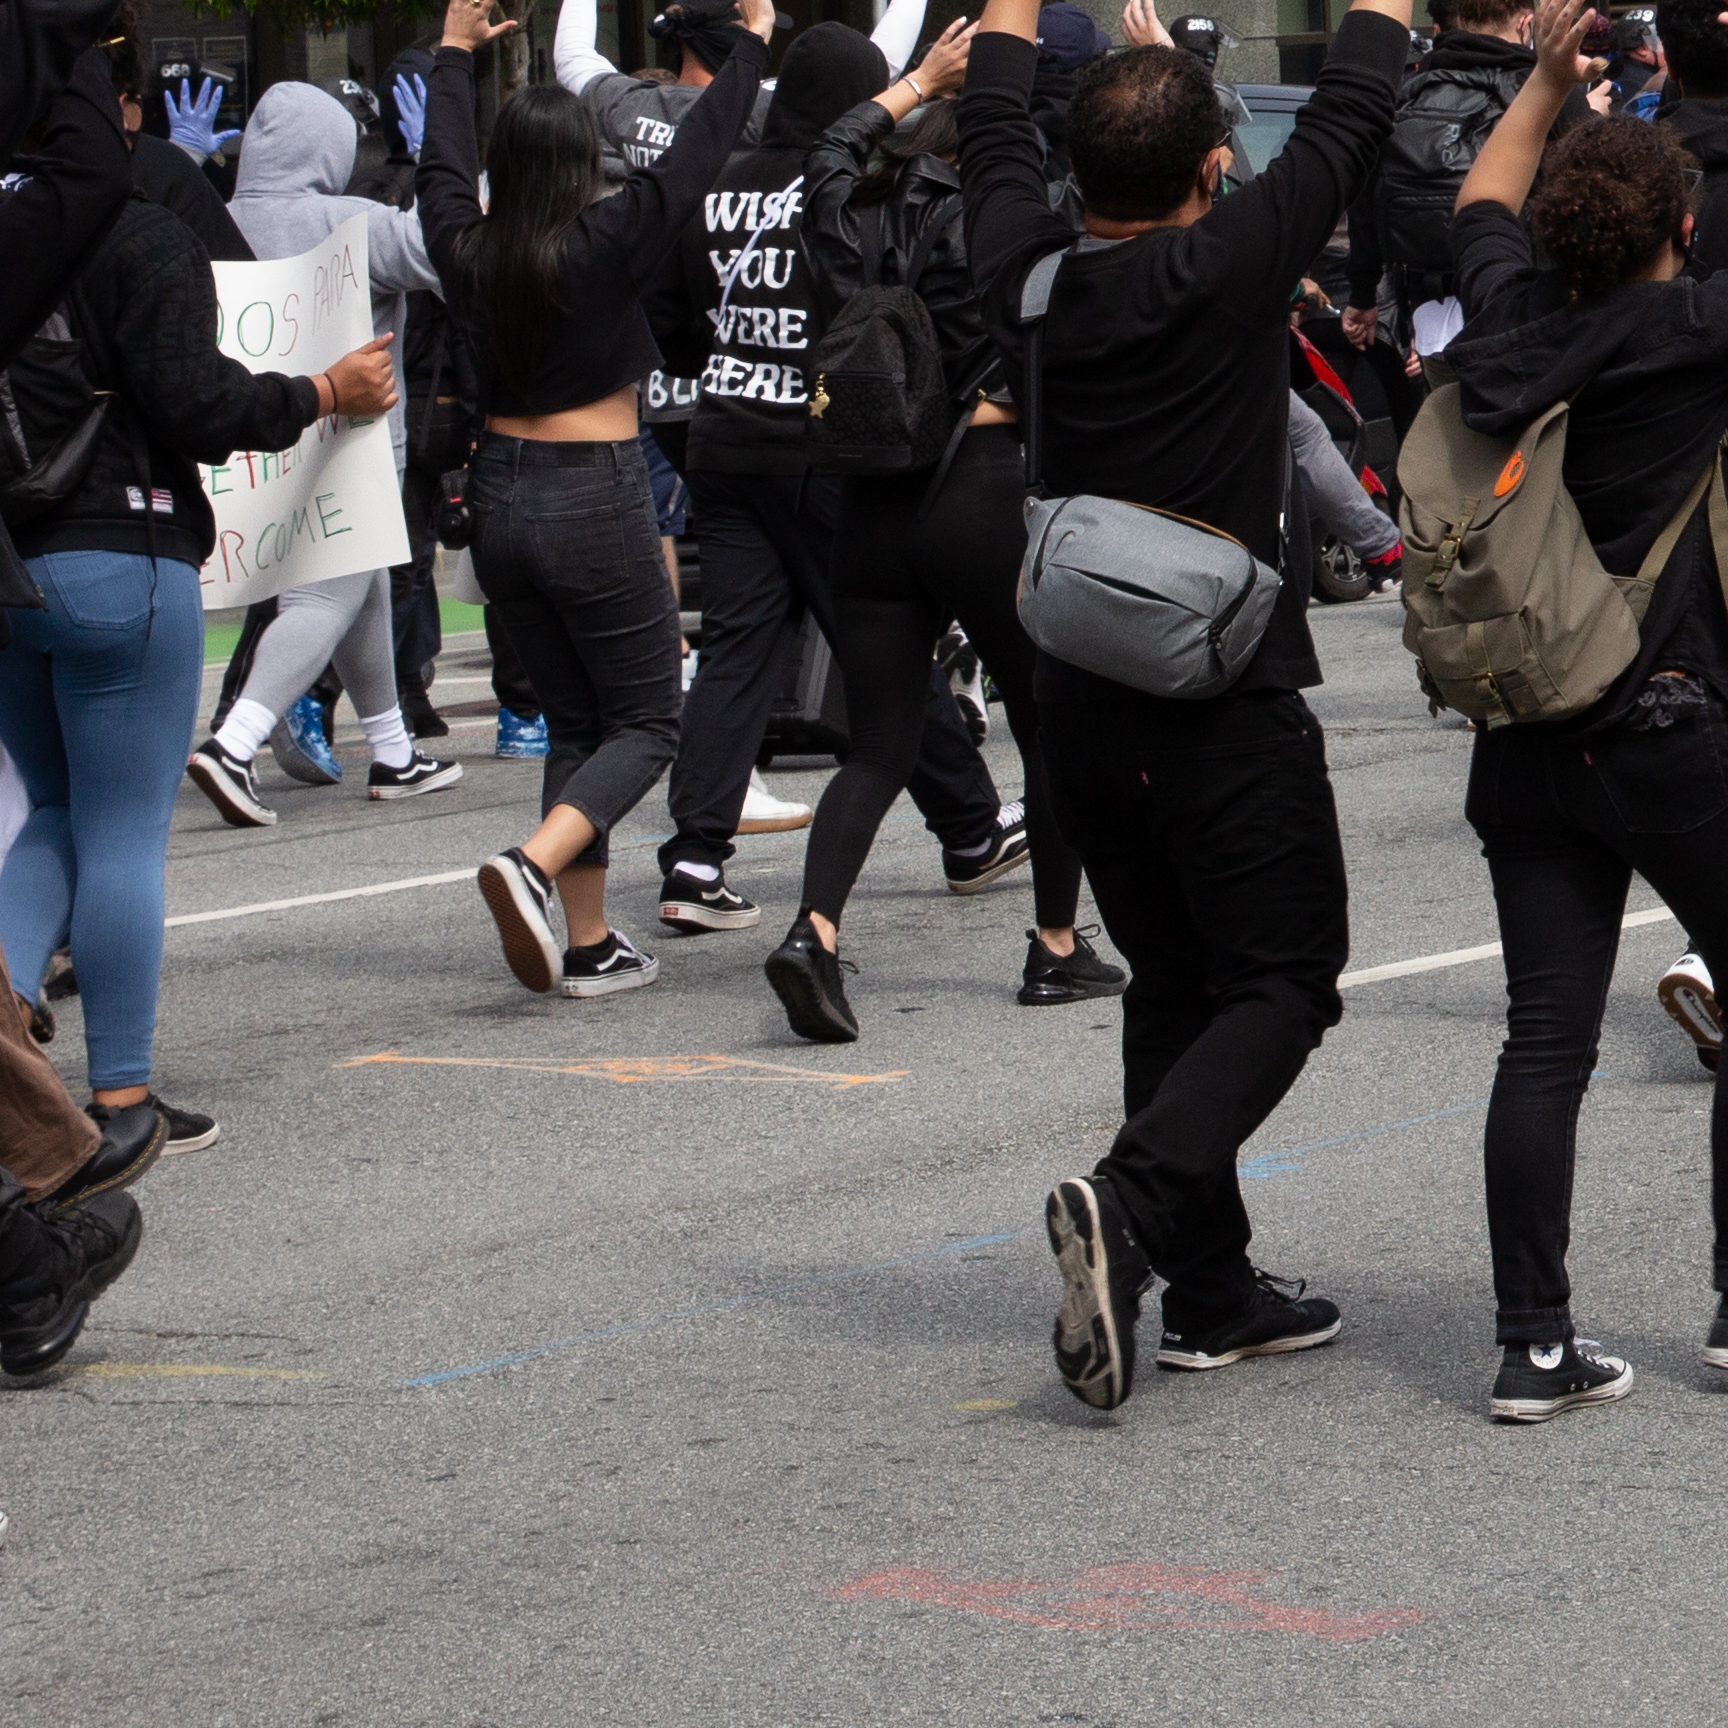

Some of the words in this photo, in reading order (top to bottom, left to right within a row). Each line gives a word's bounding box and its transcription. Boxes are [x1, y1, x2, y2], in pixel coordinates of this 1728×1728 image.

[709, 247, 796, 290] YOU
[705, 304, 808, 350] WERE
[701, 354, 808, 405] HERE
